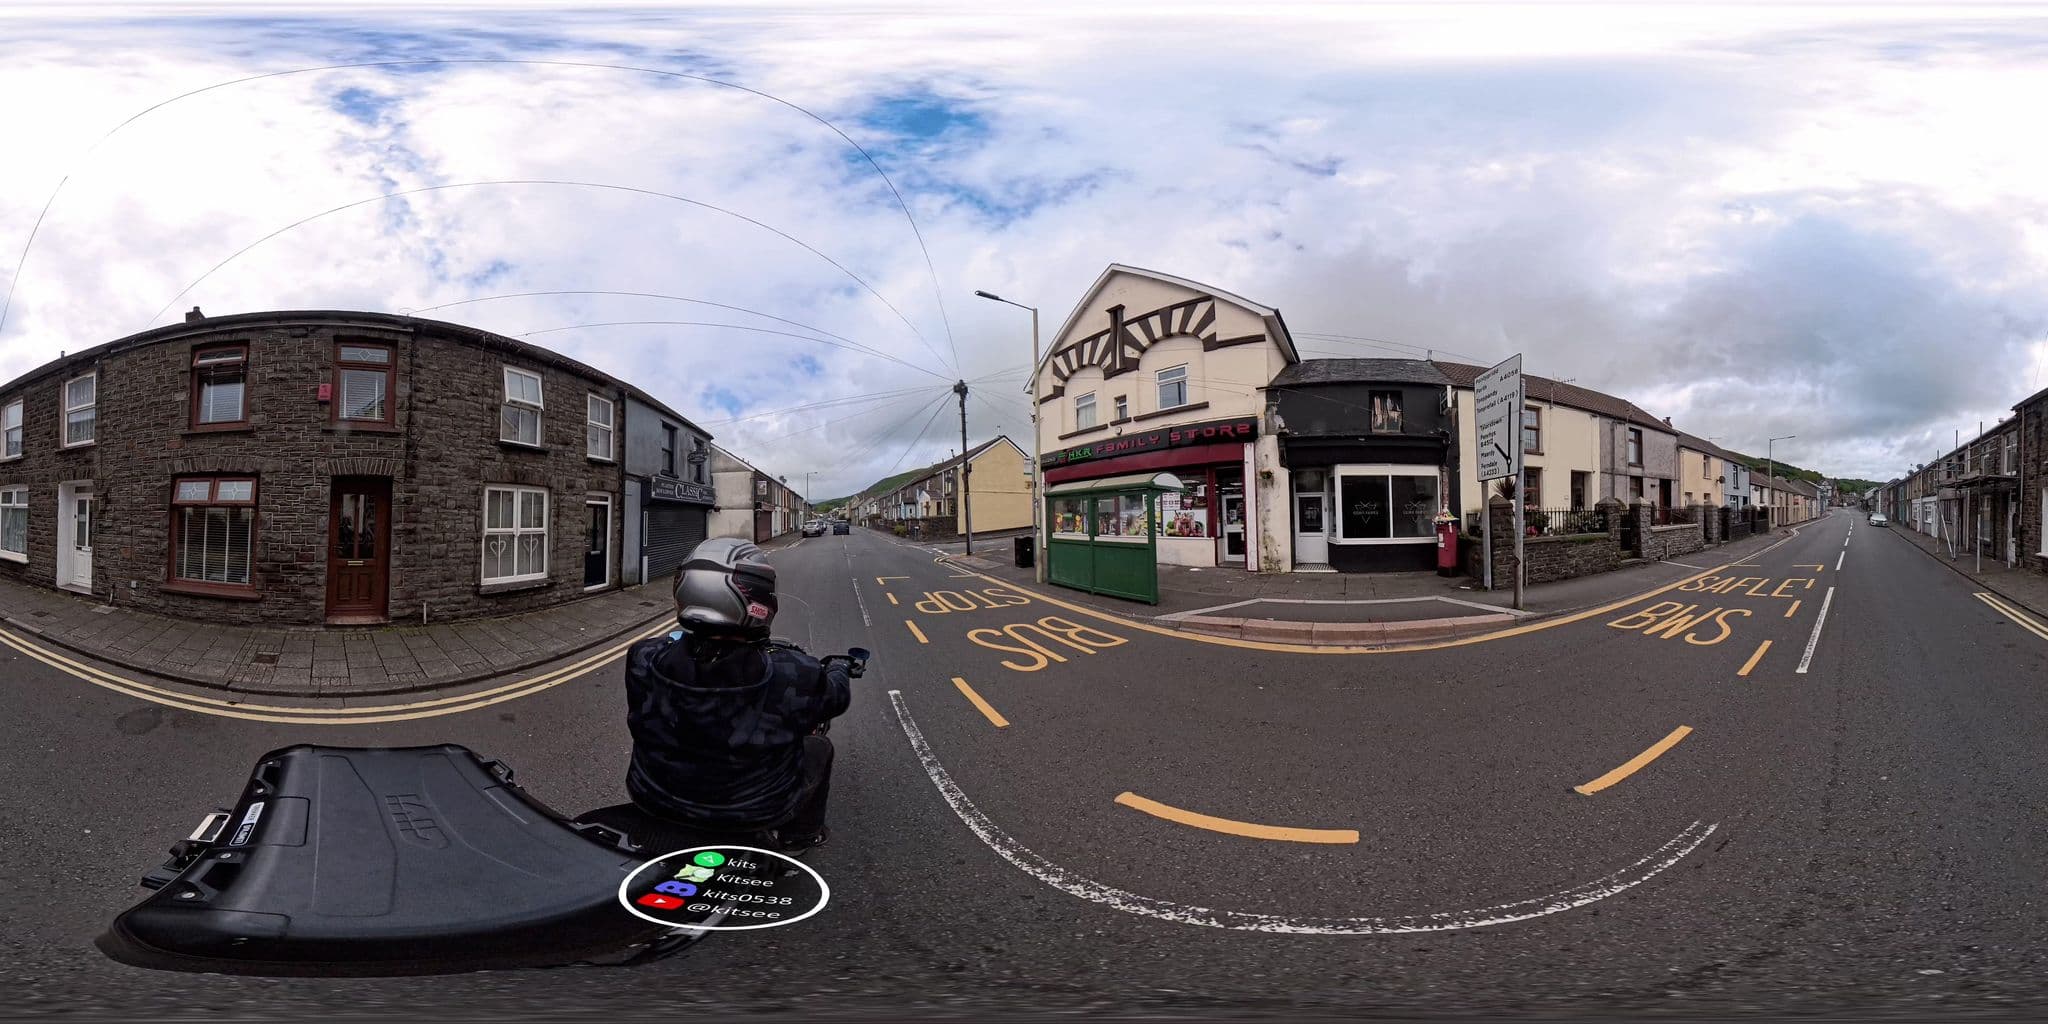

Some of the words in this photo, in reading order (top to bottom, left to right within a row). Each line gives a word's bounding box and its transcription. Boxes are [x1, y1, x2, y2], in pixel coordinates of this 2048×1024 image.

[915, 588, 1031, 614] STOP
[1678, 575, 1807, 598] SAFLE
[1606, 601, 1753, 646] BWS
[966, 616, 1129, 672] BUS
